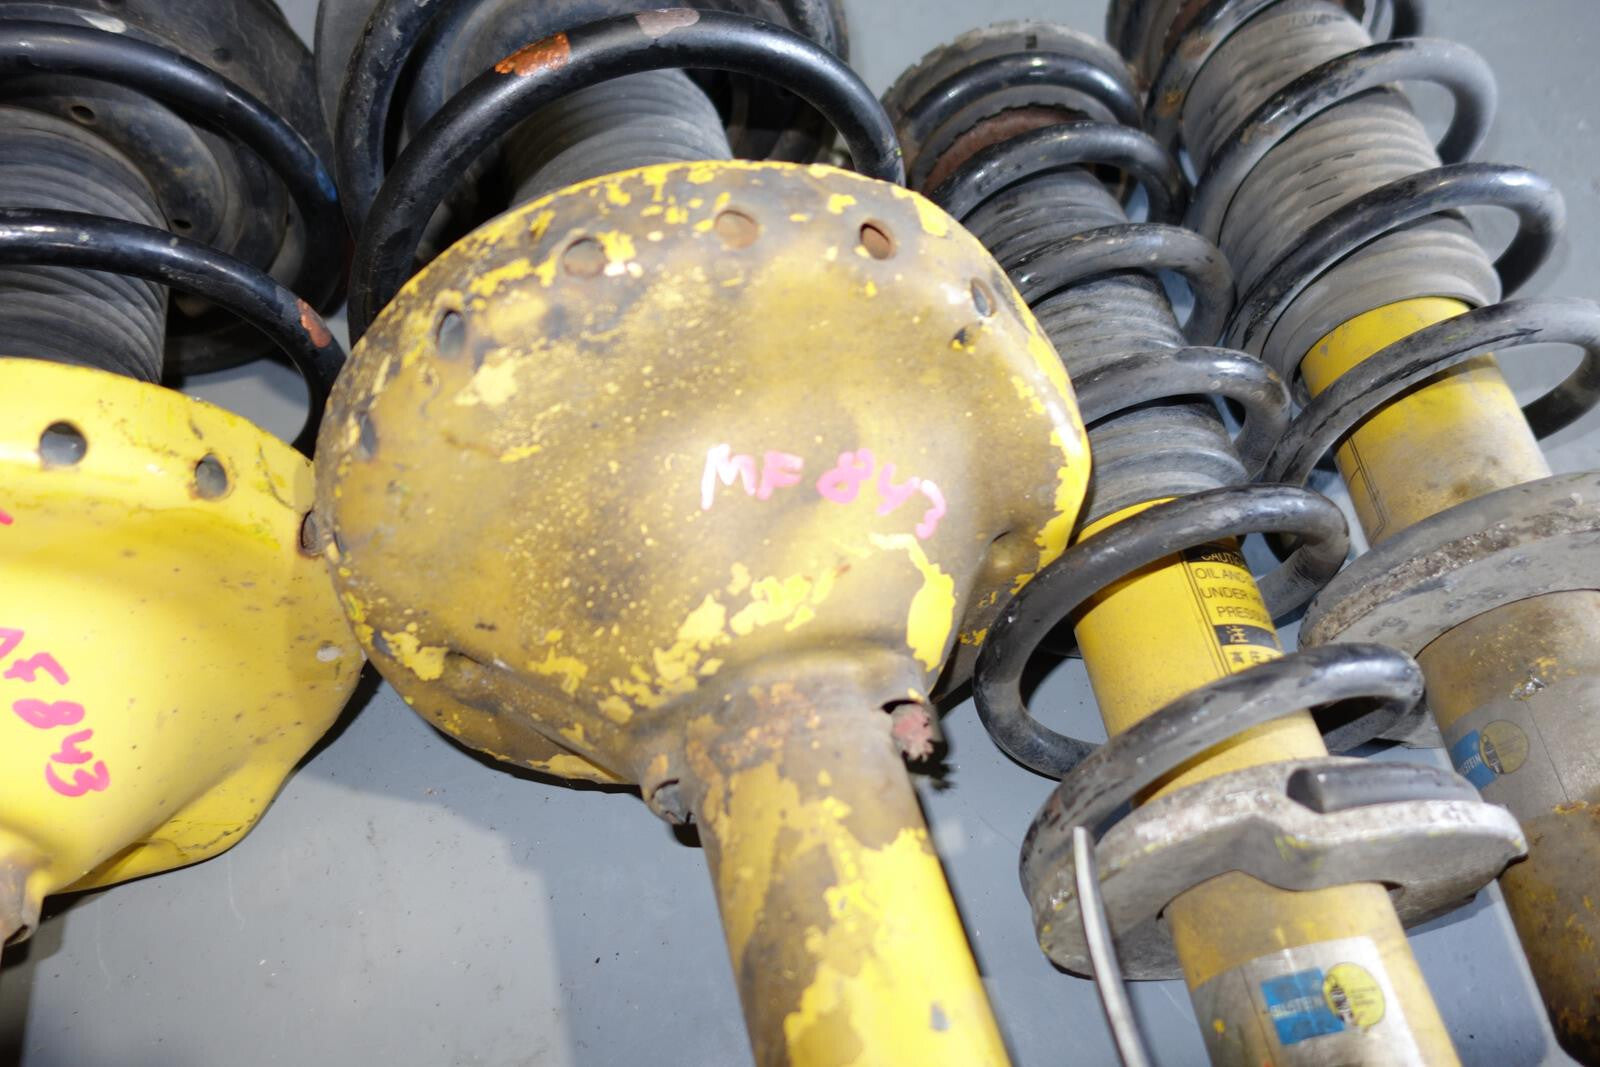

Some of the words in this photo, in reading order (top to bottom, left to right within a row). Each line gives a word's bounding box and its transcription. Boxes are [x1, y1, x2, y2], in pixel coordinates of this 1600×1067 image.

[700, 443, 804, 511] MF
[1194, 567, 1221, 580] OIL
[1200, 586, 1249, 600] UNDER
[12, 698, 111, 798] 843
